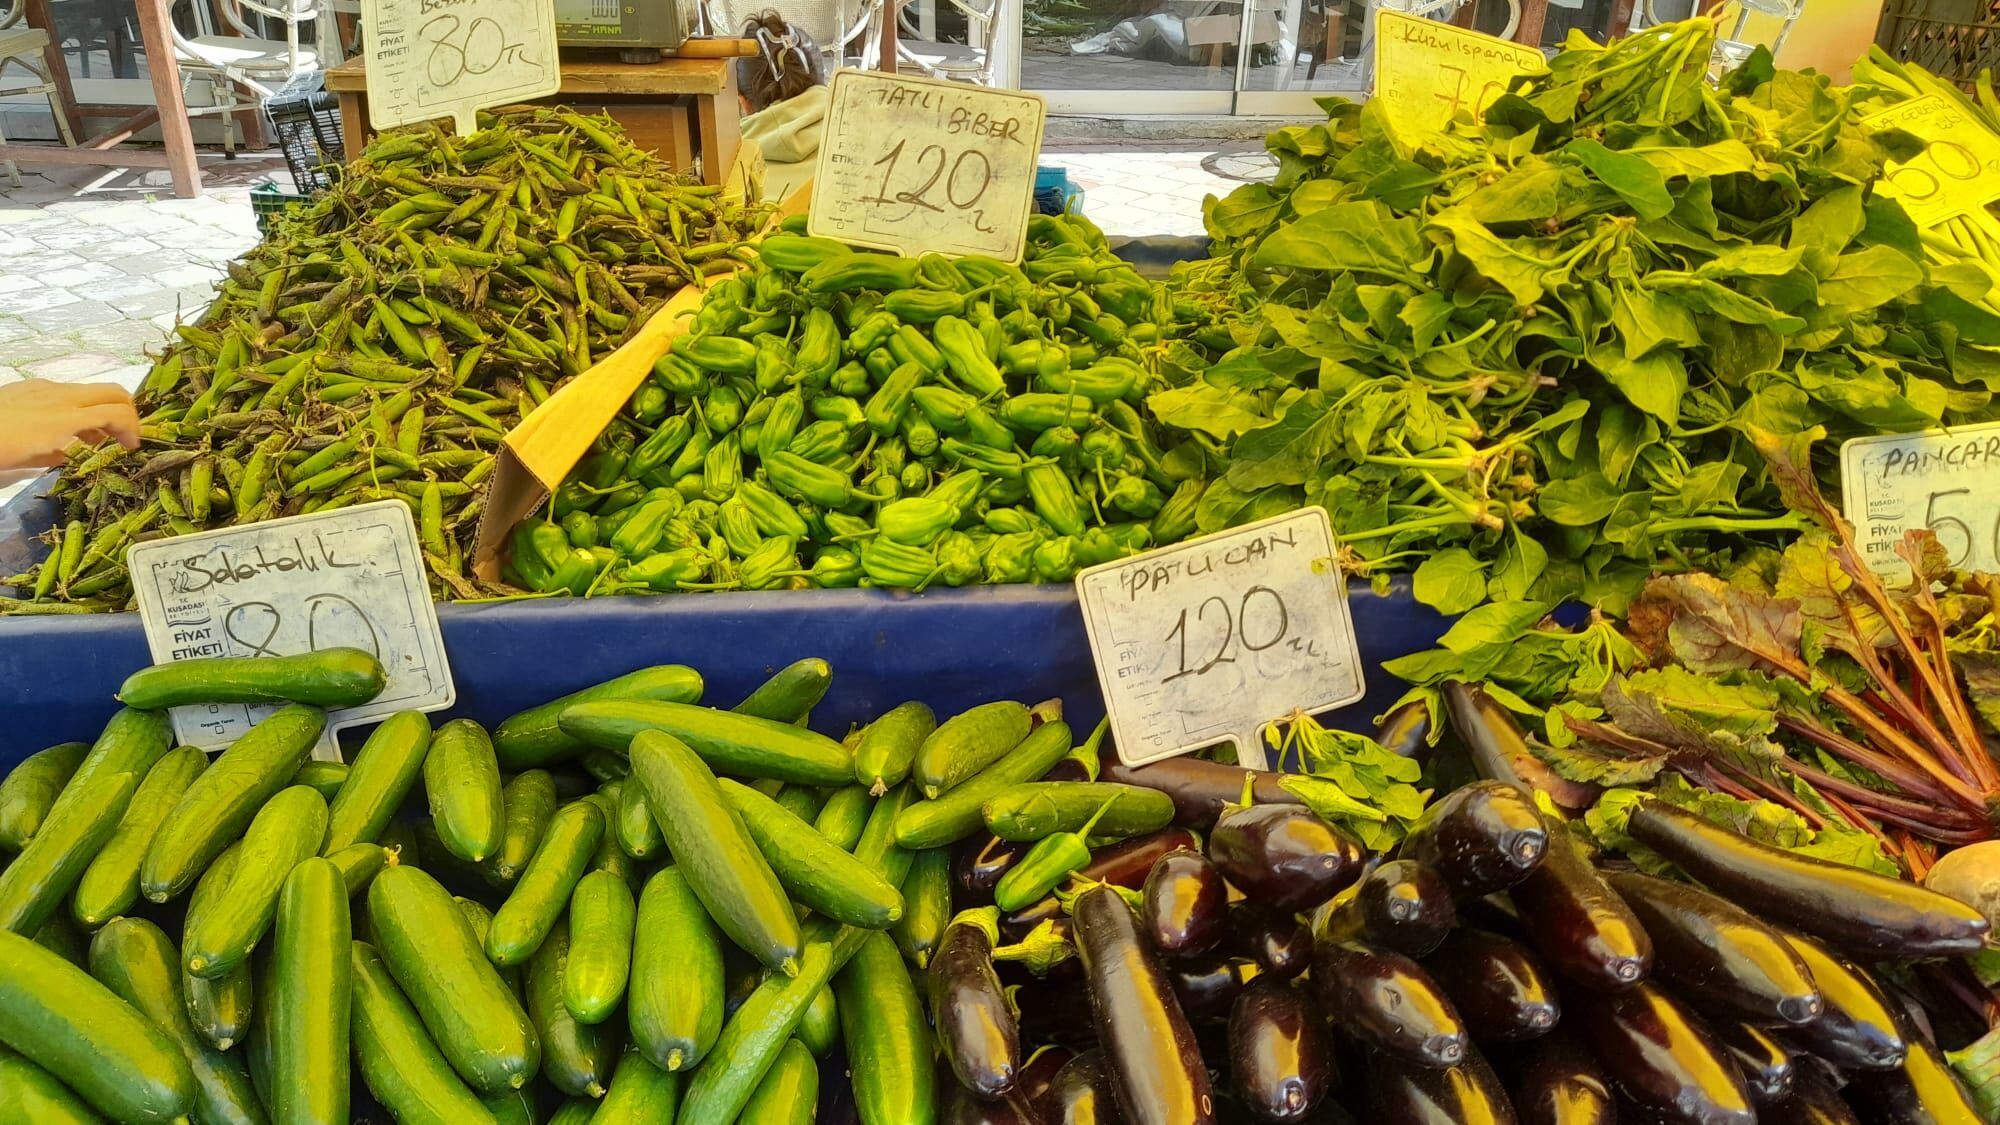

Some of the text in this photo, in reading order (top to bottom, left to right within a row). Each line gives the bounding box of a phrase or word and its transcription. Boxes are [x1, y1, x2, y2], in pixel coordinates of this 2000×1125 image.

[380, 35, 405, 48] FİYAT
[860, 138, 991, 214] 120
[174, 628, 212, 644] FİYAT
[1160, 584, 1288, 685] 120
[172, 640, 223, 660] ETİKETİ
